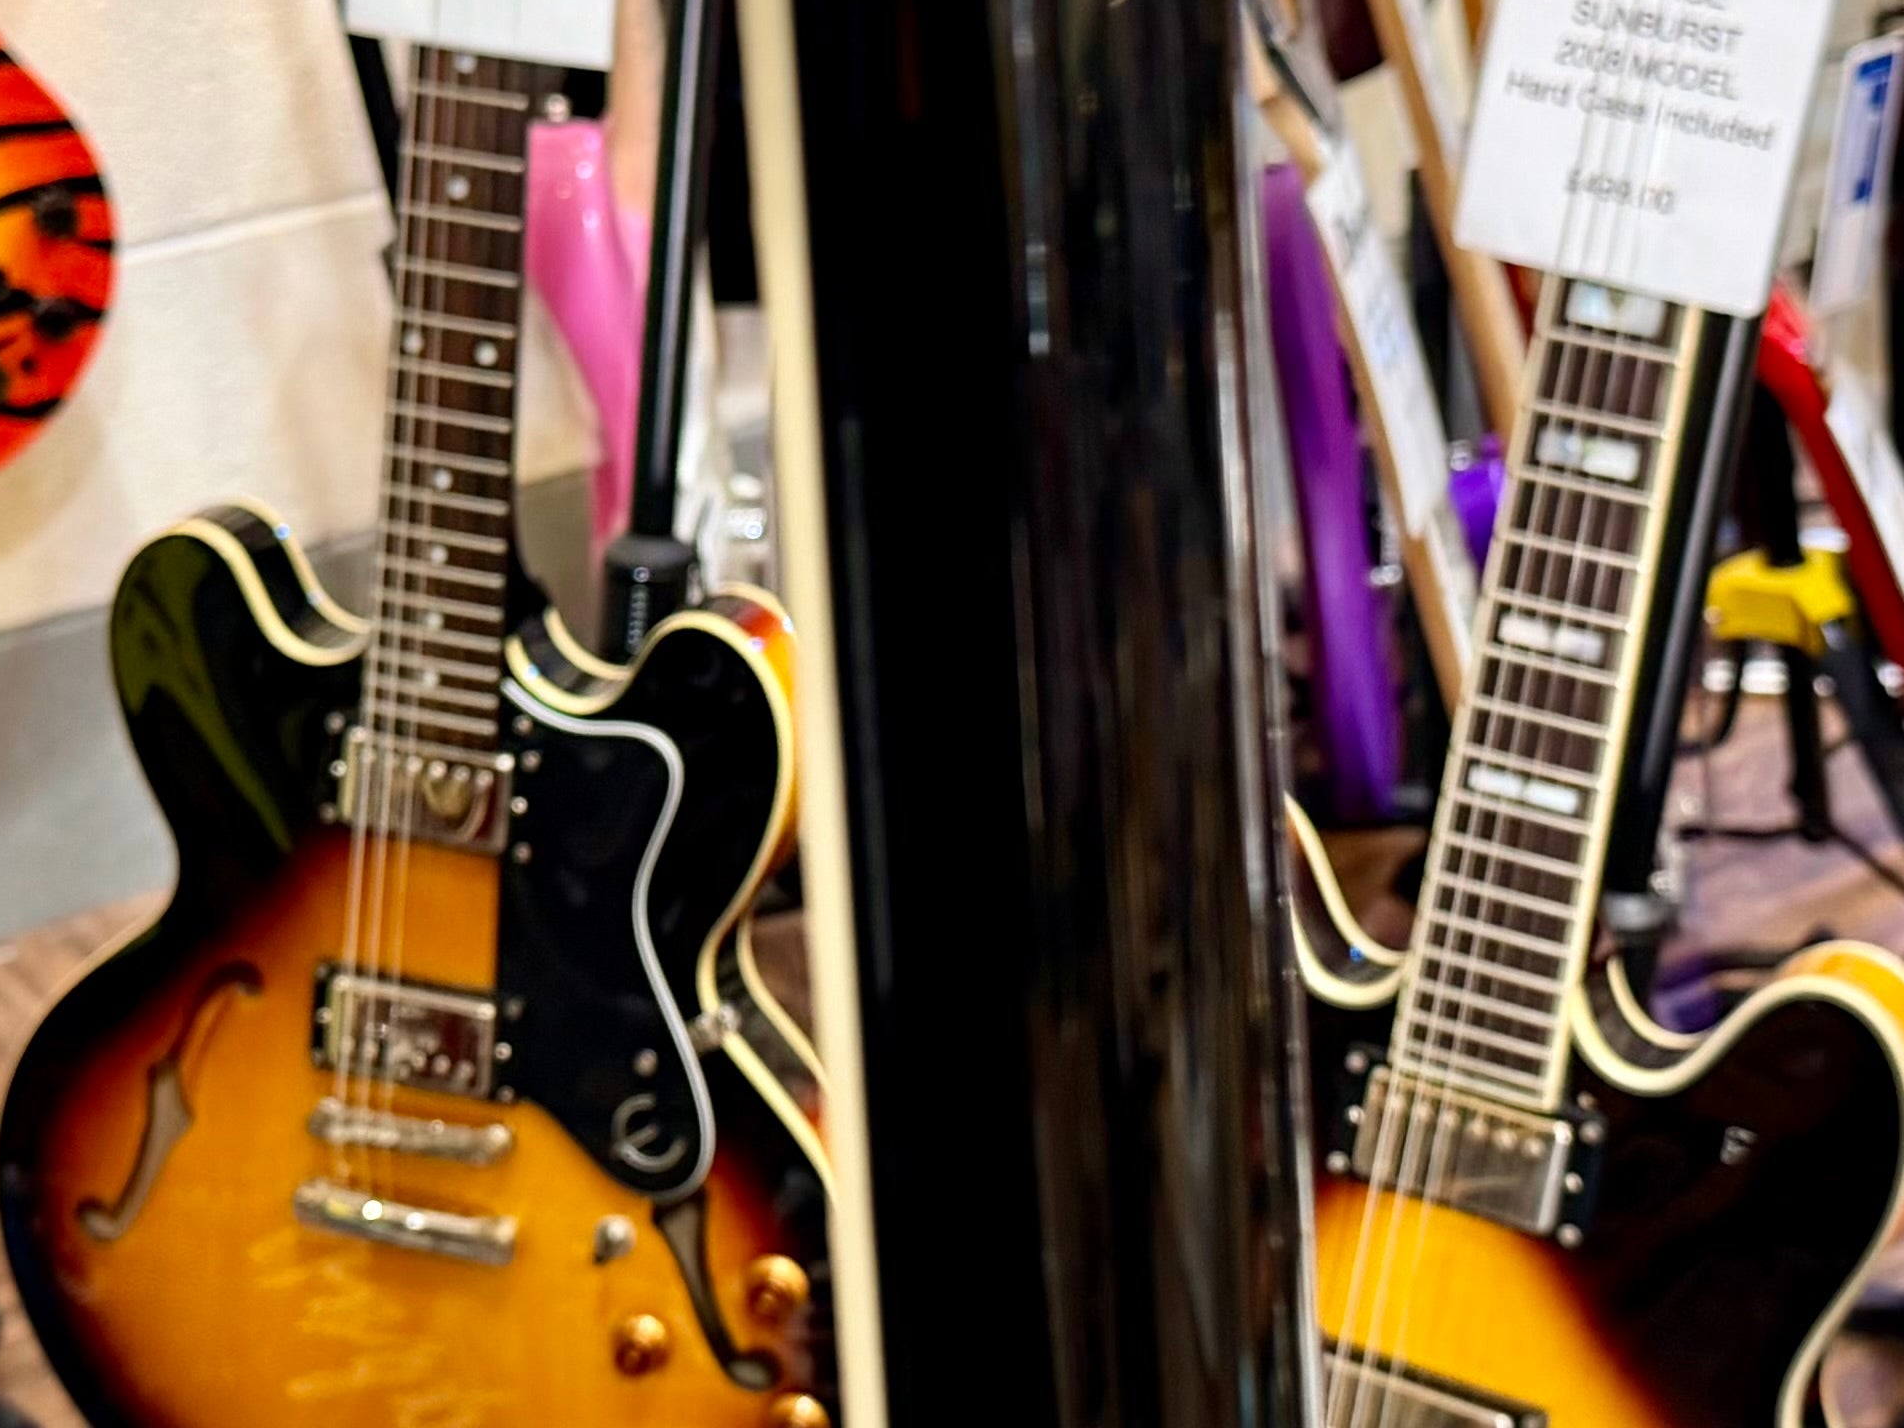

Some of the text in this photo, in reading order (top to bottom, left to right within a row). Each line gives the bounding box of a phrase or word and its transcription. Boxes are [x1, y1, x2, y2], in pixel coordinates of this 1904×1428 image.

[1629, 55, 1740, 100] MODEL
[1505, 70, 1774, 150] Hard Case Included
